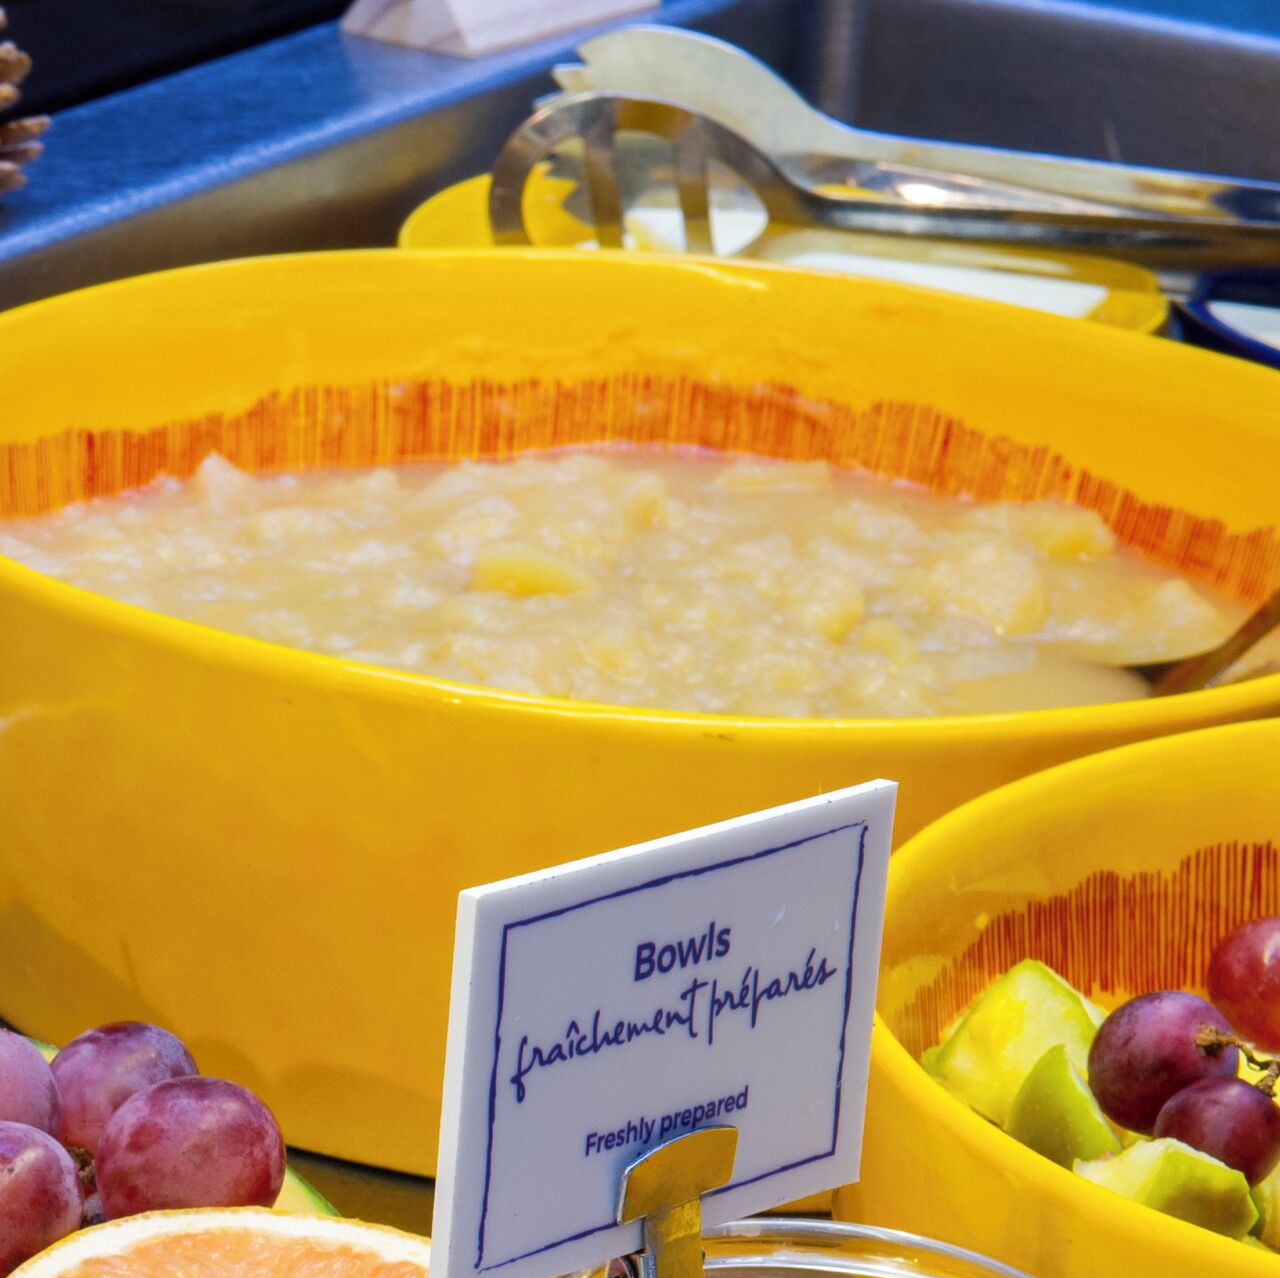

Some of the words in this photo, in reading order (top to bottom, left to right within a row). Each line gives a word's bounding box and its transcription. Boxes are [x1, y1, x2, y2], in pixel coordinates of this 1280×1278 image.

[634, 921, 732, 982] Bowls
[510, 978, 709, 1104] fraîchement
[708, 948, 837, 1045] préparés
[584, 1116, 657, 1157] Freshly
[660, 1084, 750, 1140] prepared
